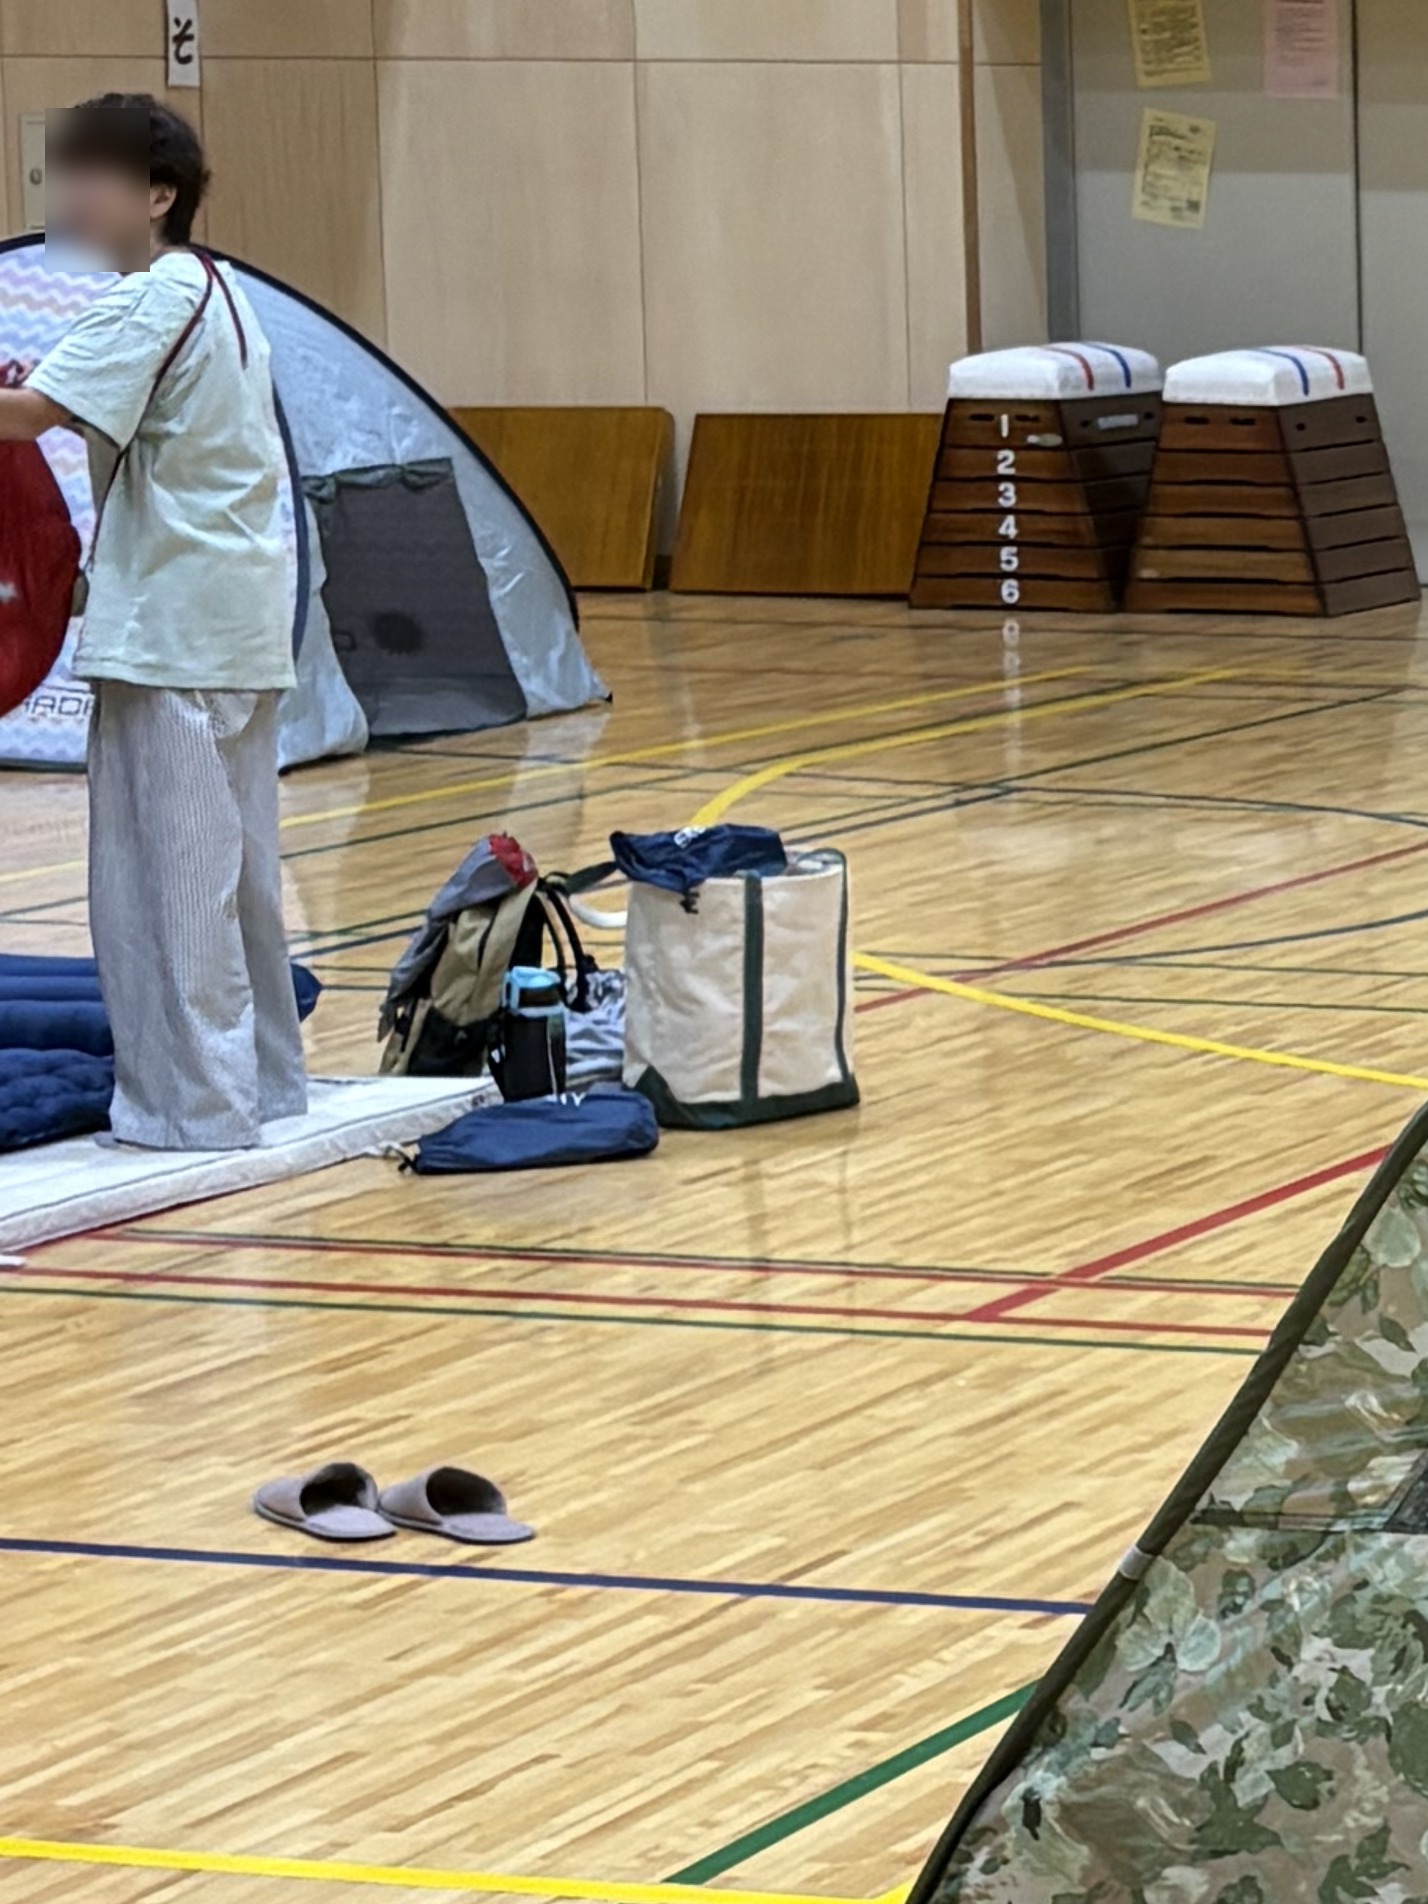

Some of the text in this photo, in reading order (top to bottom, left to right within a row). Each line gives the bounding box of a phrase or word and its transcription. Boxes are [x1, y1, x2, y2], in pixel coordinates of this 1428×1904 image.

[1001, 413, 1009, 438] 1
[997, 450, 1016, 475] 2
[998, 482, 1017, 508] 3
[998, 514, 1018, 539] 4
[1000, 546, 1019, 572] 5
[1001, 578, 1020, 604] 6
